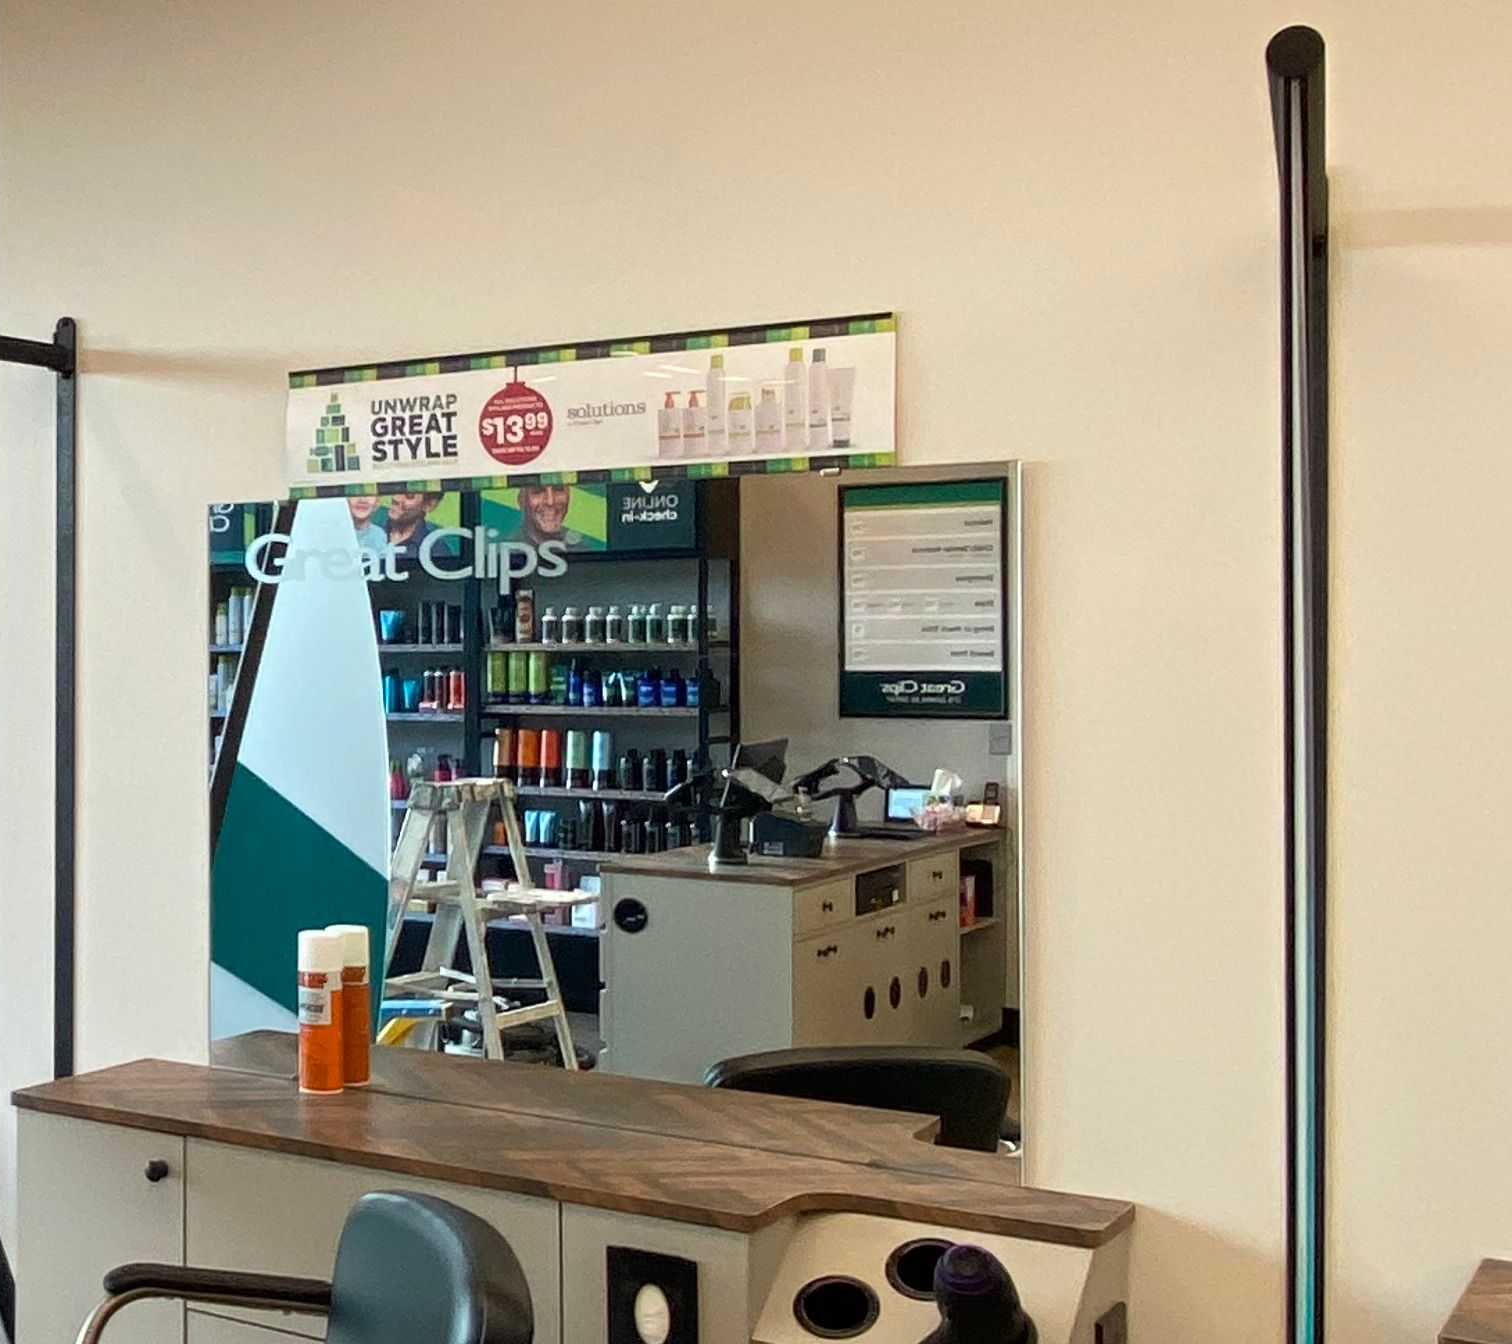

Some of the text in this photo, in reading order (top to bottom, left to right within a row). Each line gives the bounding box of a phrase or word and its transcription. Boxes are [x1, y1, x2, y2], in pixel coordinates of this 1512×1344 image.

[370, 394, 457, 416] UNWRAP
[567, 402, 646, 419] solutions
[371, 411, 457, 438] GREAT
[372, 434, 458, 462] STYLE
[245, 525, 568, 595] Great Clips
